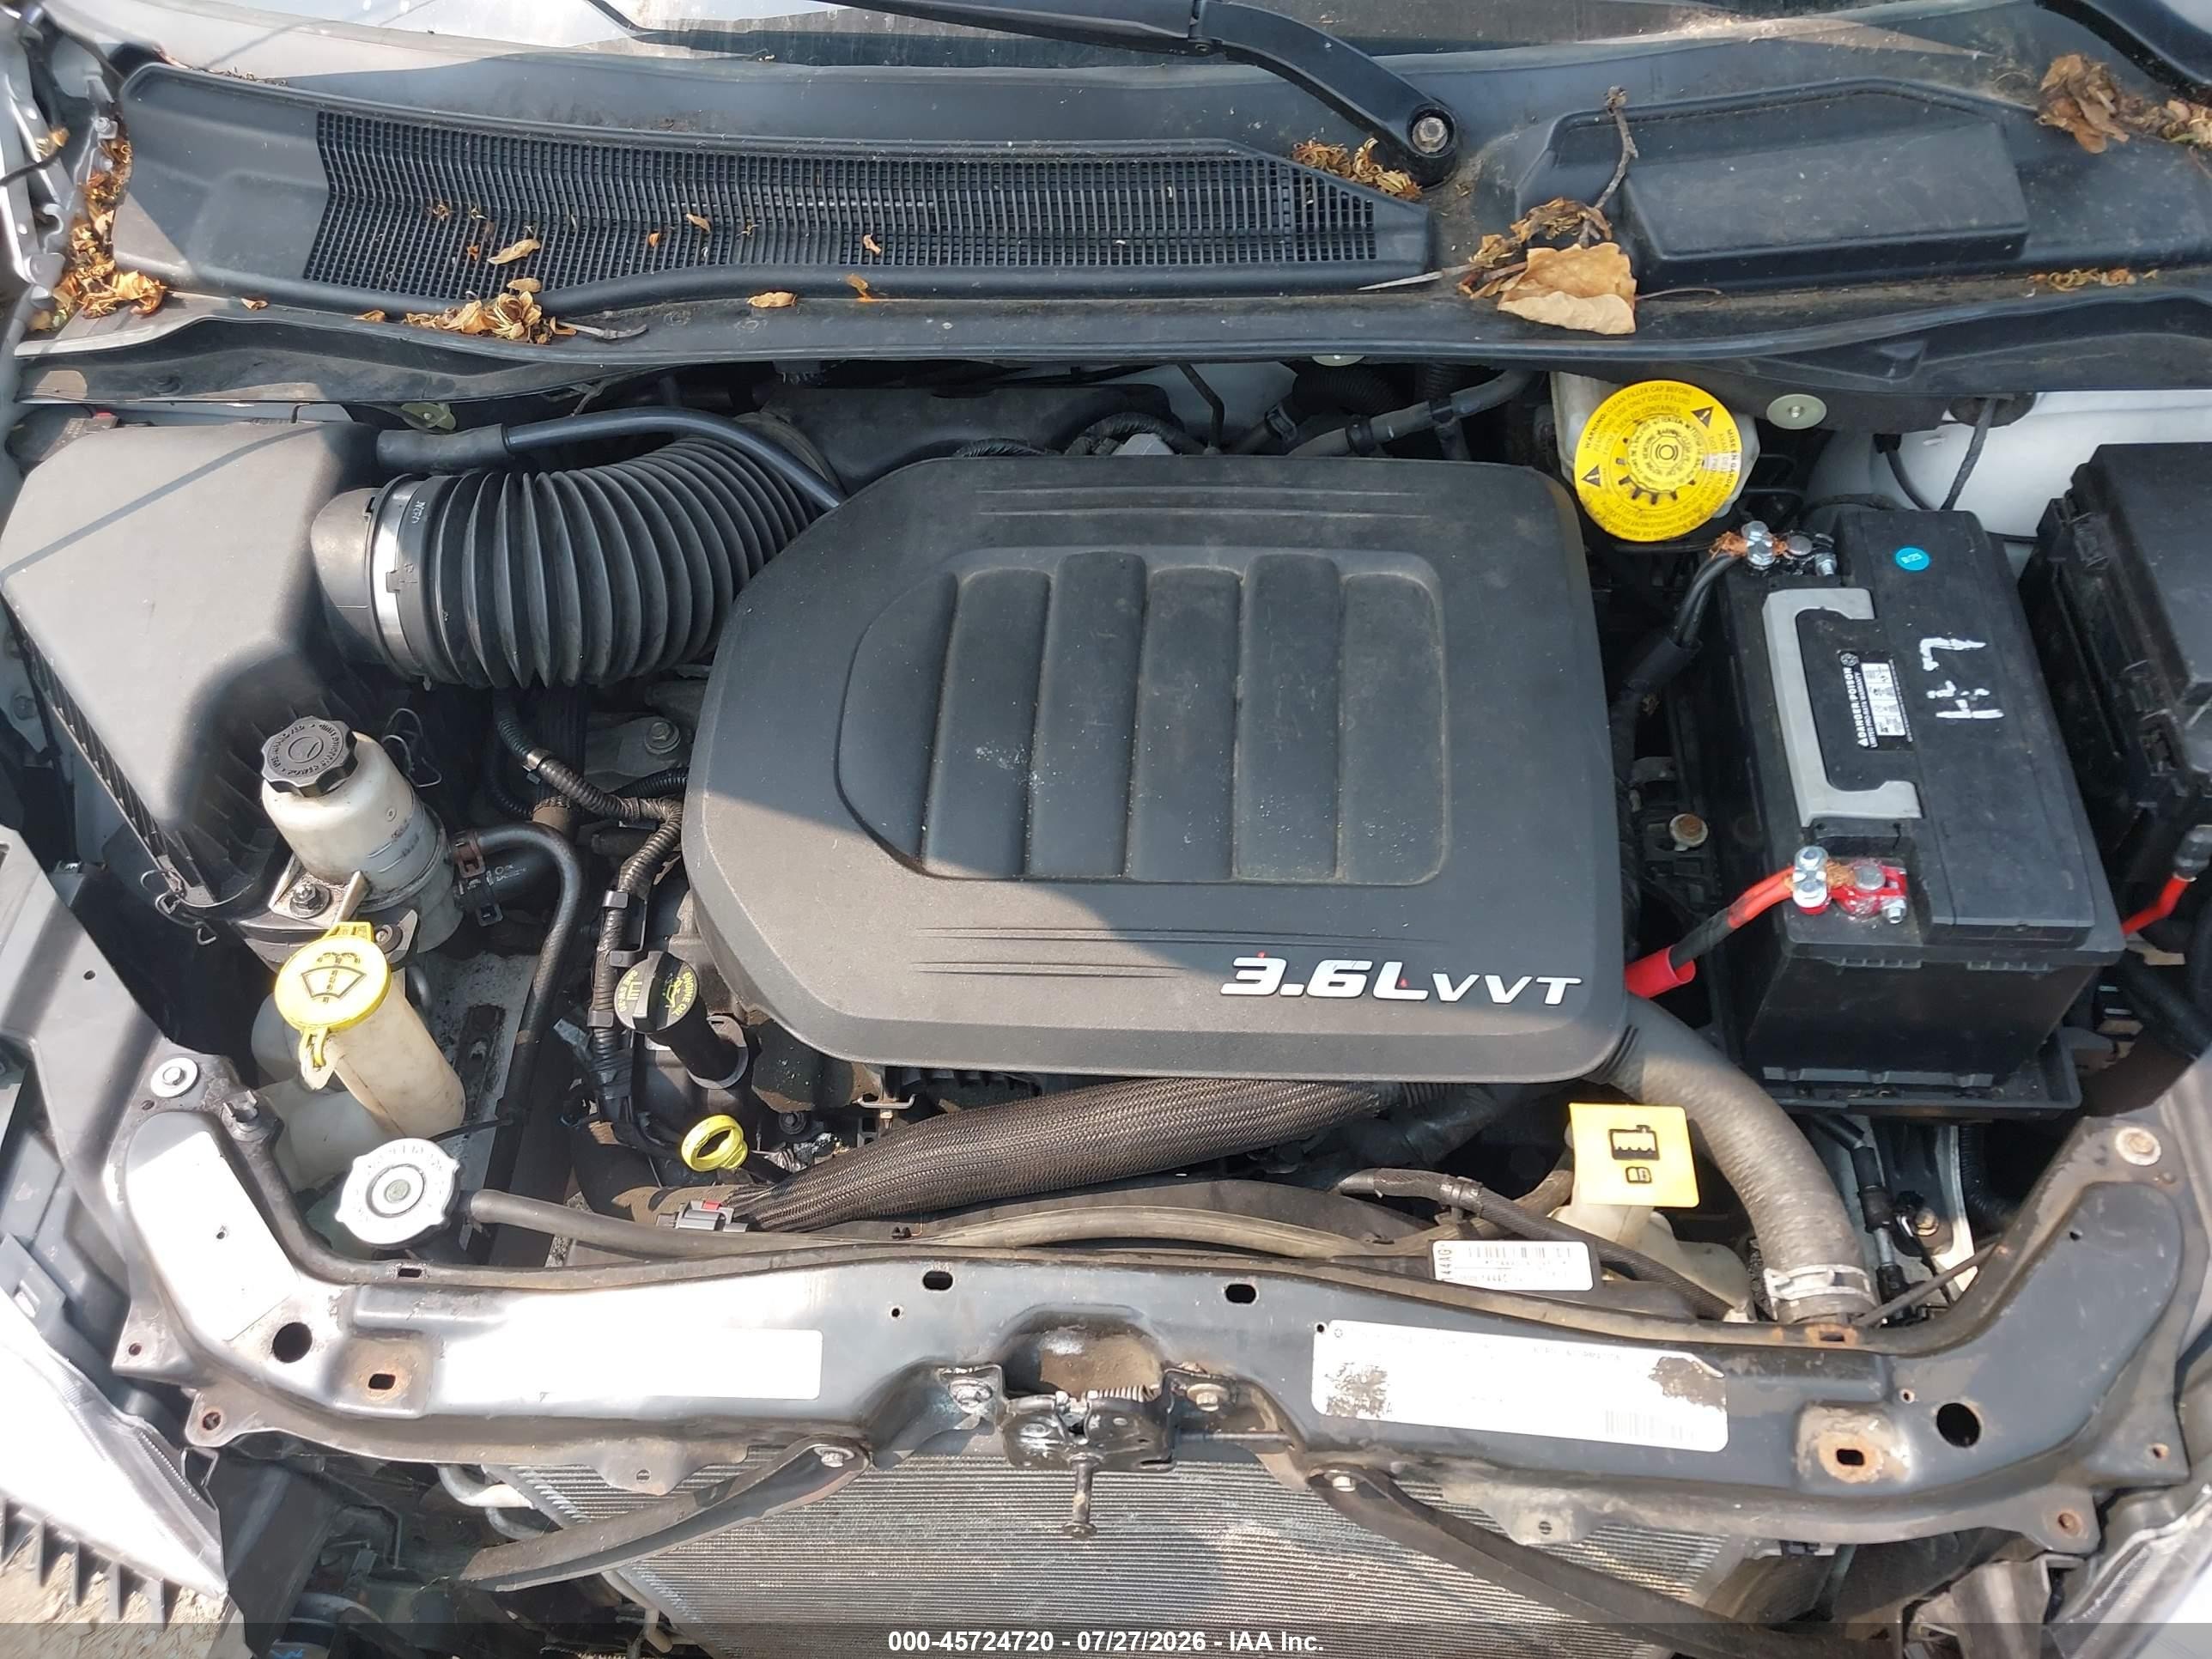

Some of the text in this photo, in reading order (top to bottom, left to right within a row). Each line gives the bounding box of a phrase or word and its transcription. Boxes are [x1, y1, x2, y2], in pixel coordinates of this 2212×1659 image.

[1585, 412, 1607, 447] WARNING:
[1607, 397, 1626, 413] CLEAN
[1626, 387, 1649, 398] FILLER
[1666, 385, 1692, 396] BEFORE
[1727, 428, 1736, 447] MISE
[1730, 450, 1738, 460] EN
[1843, 666, 1867, 738] DANGER/POISON
[1854, 672, 1866, 701] WARRANTY
[622, 969, 639, 986] SAE
[672, 971, 695, 1017] ENGINE OIL
[1219, 957, 1583, 1006] 3.6L VVT
